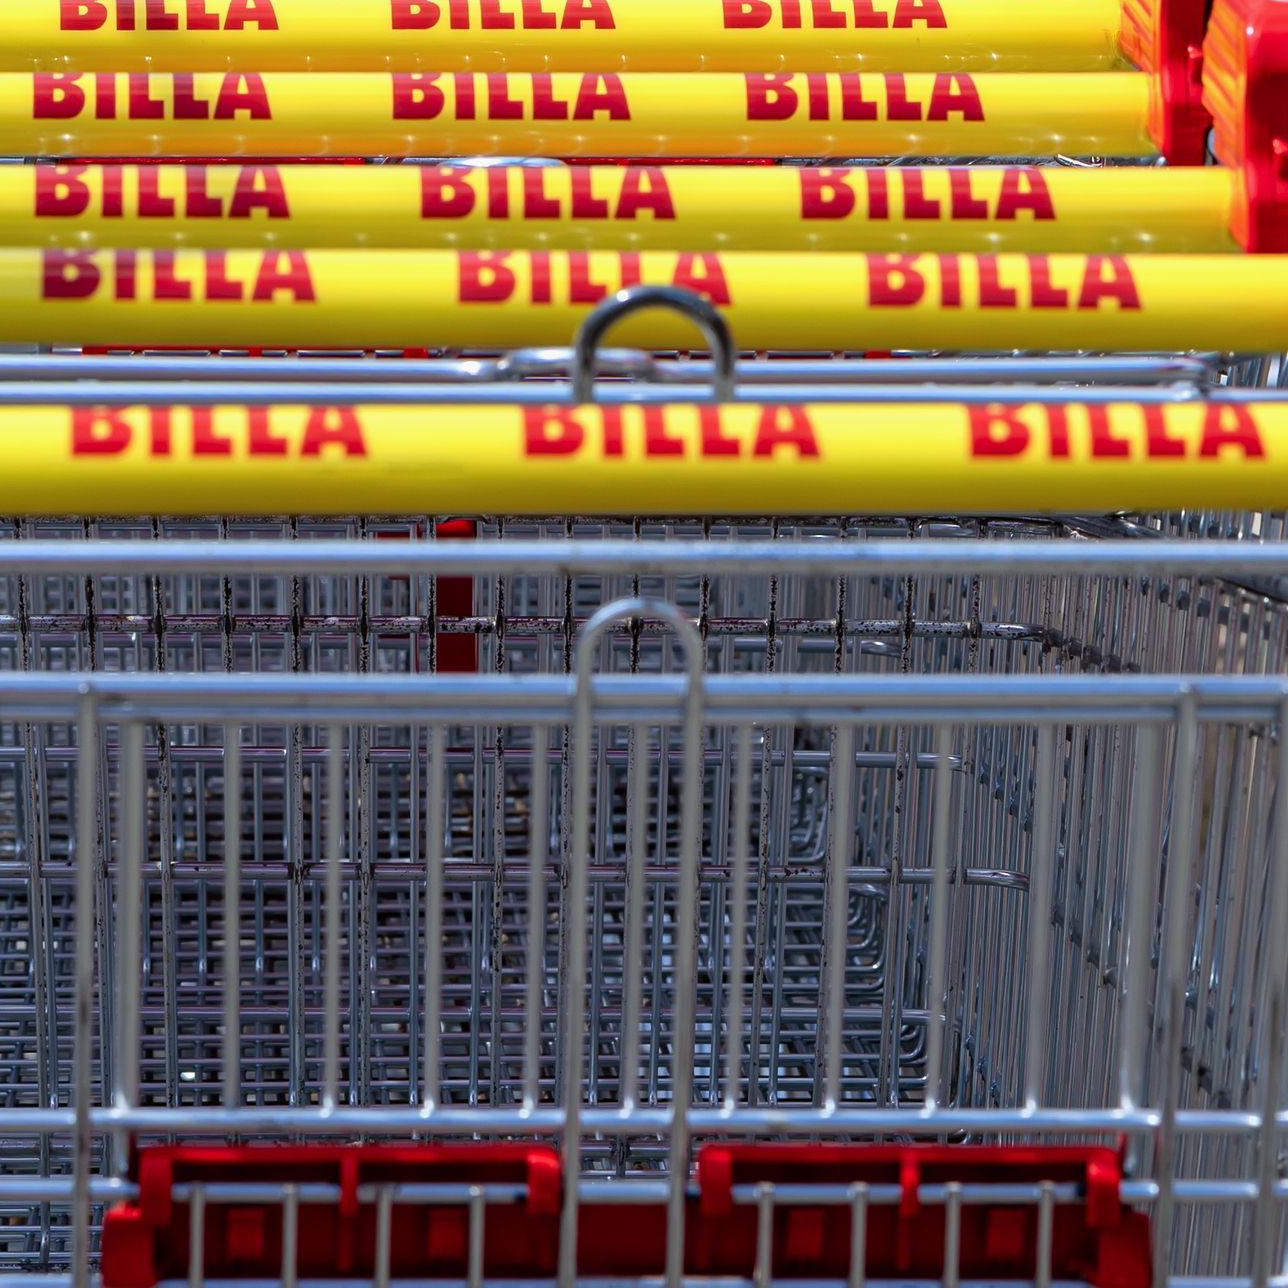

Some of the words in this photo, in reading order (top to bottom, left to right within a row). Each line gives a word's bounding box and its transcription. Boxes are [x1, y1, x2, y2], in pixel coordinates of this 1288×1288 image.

[32, 72, 272, 120] BILLA
[392, 72, 632, 121] BILLA
[745, 73, 985, 122] BILLA
[34, 165, 290, 219] BILLA
[420, 166, 676, 220] BILLA
[800, 168, 1056, 221] BILLA
[42, 250, 316, 302] BILLA
[868, 255, 1142, 310] BILLA
[70, 404, 368, 459] BILLA
[523, 404, 820, 460] BILLA
[967, 404, 1266, 461] BILLA
